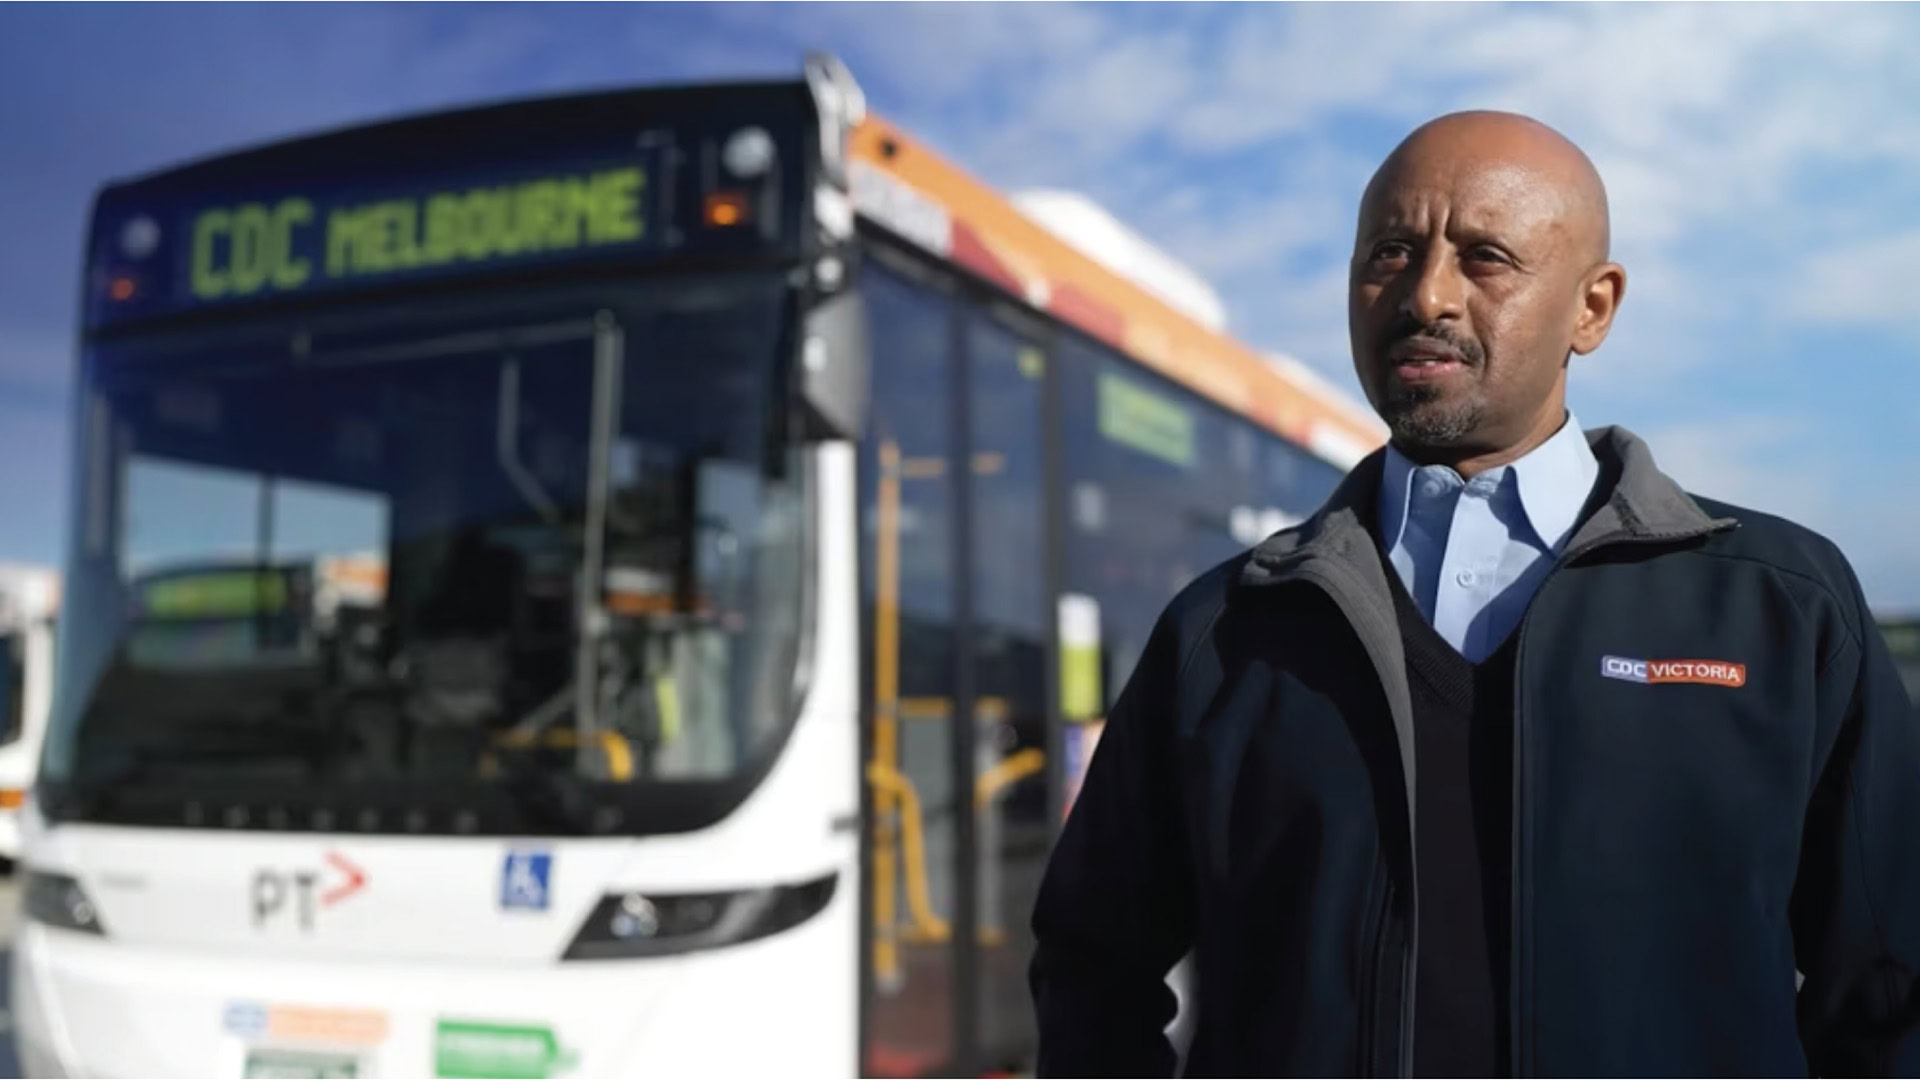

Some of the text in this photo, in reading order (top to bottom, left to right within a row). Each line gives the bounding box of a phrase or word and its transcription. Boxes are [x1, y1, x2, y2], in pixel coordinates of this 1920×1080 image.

[193, 168, 644, 298] CDC MELBOURNE
[1606, 658, 1741, 681] CDC VICTORIA
